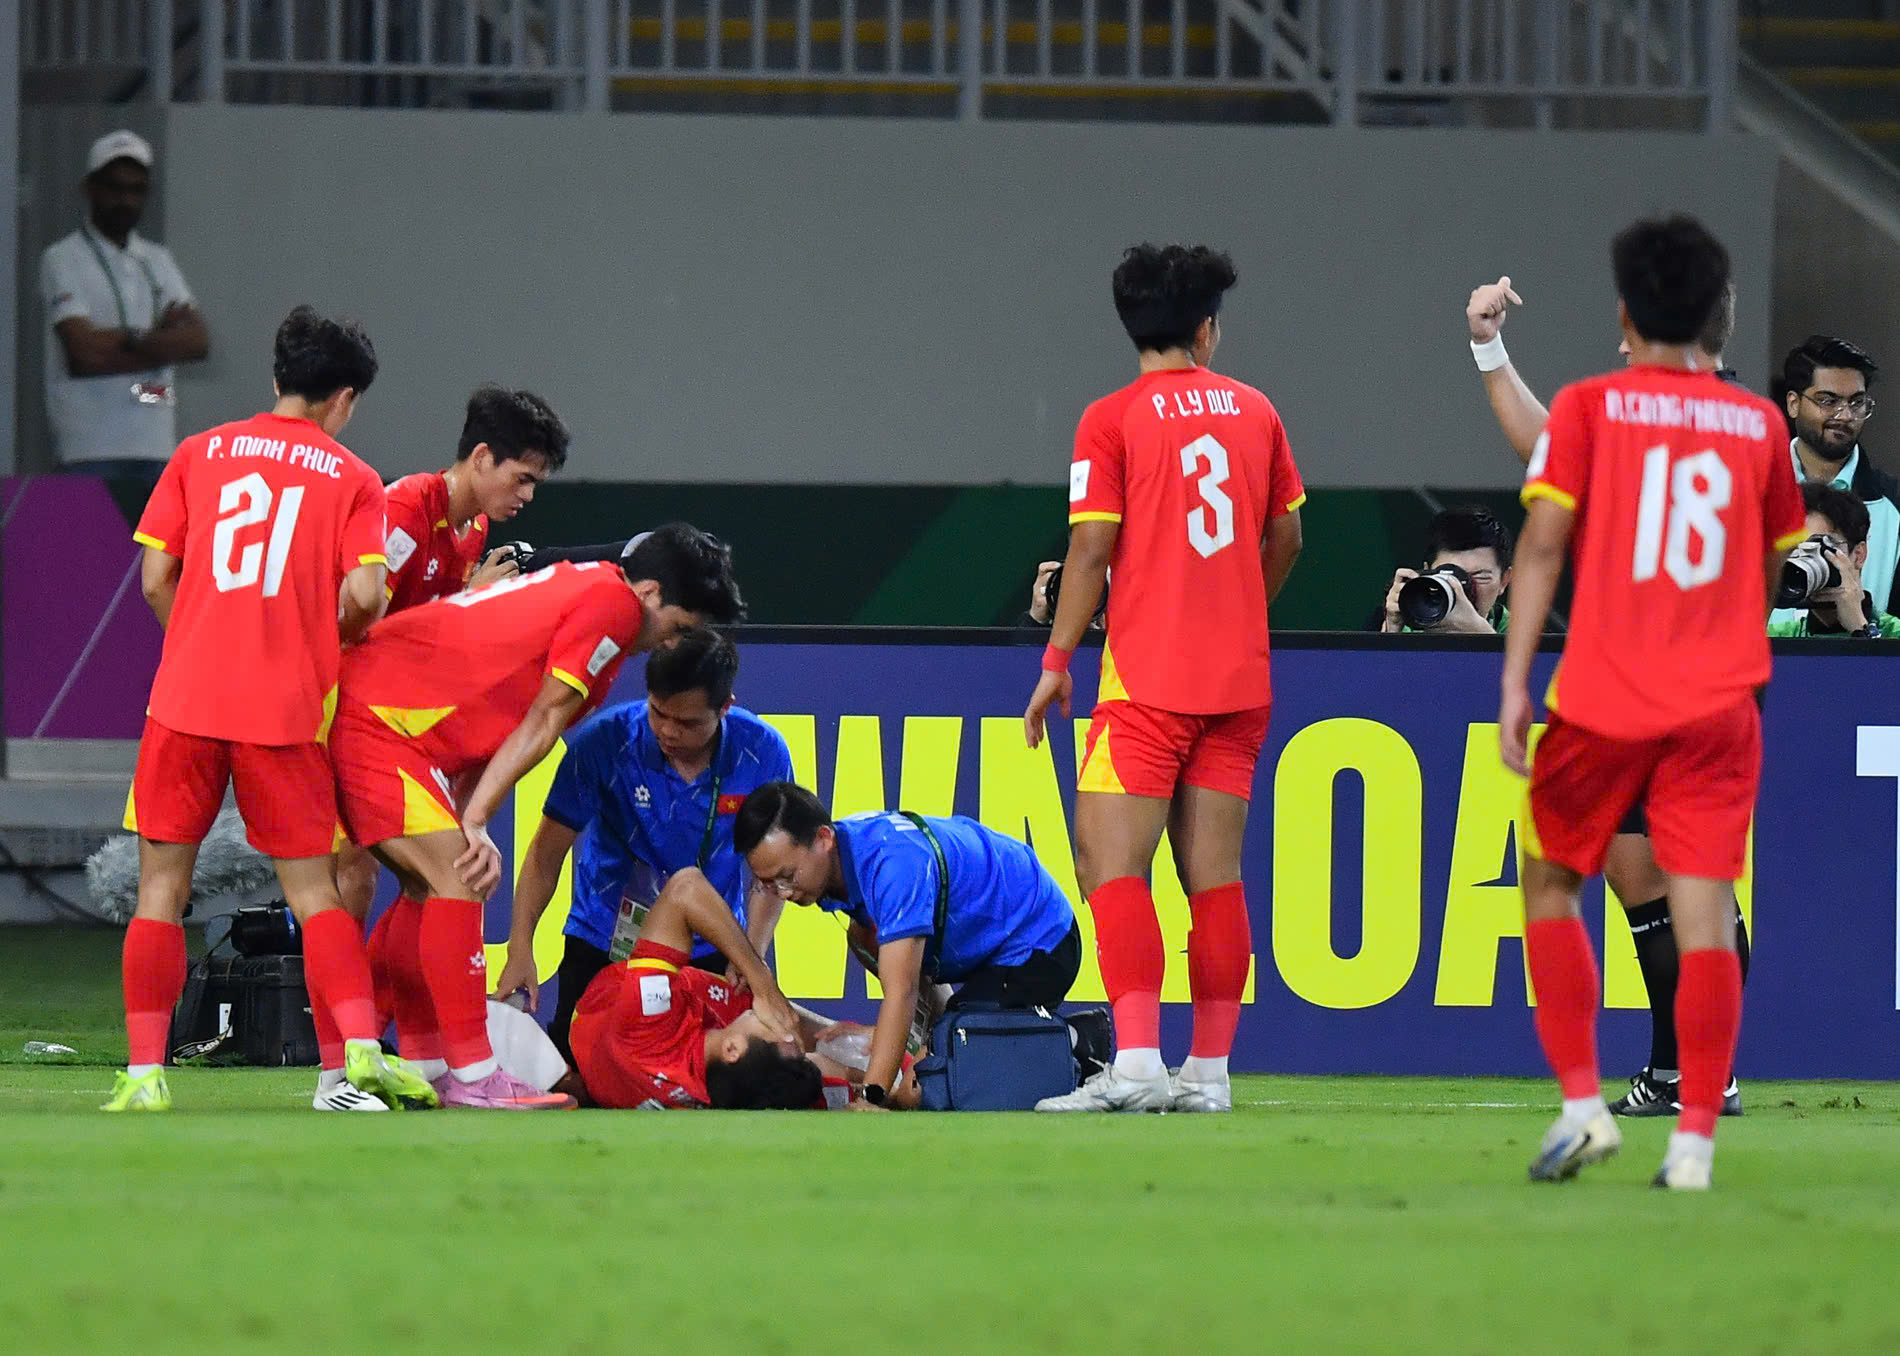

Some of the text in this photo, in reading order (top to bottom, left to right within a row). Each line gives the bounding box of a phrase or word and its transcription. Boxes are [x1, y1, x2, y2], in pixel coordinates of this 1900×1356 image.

[206, 435, 344, 479] P. MINH PHUC
[1205, 389, 1241, 415] DUC
[212, 472, 305, 598] 21
[1180, 433, 1235, 559] 3
[1632, 444, 1732, 591] 18
